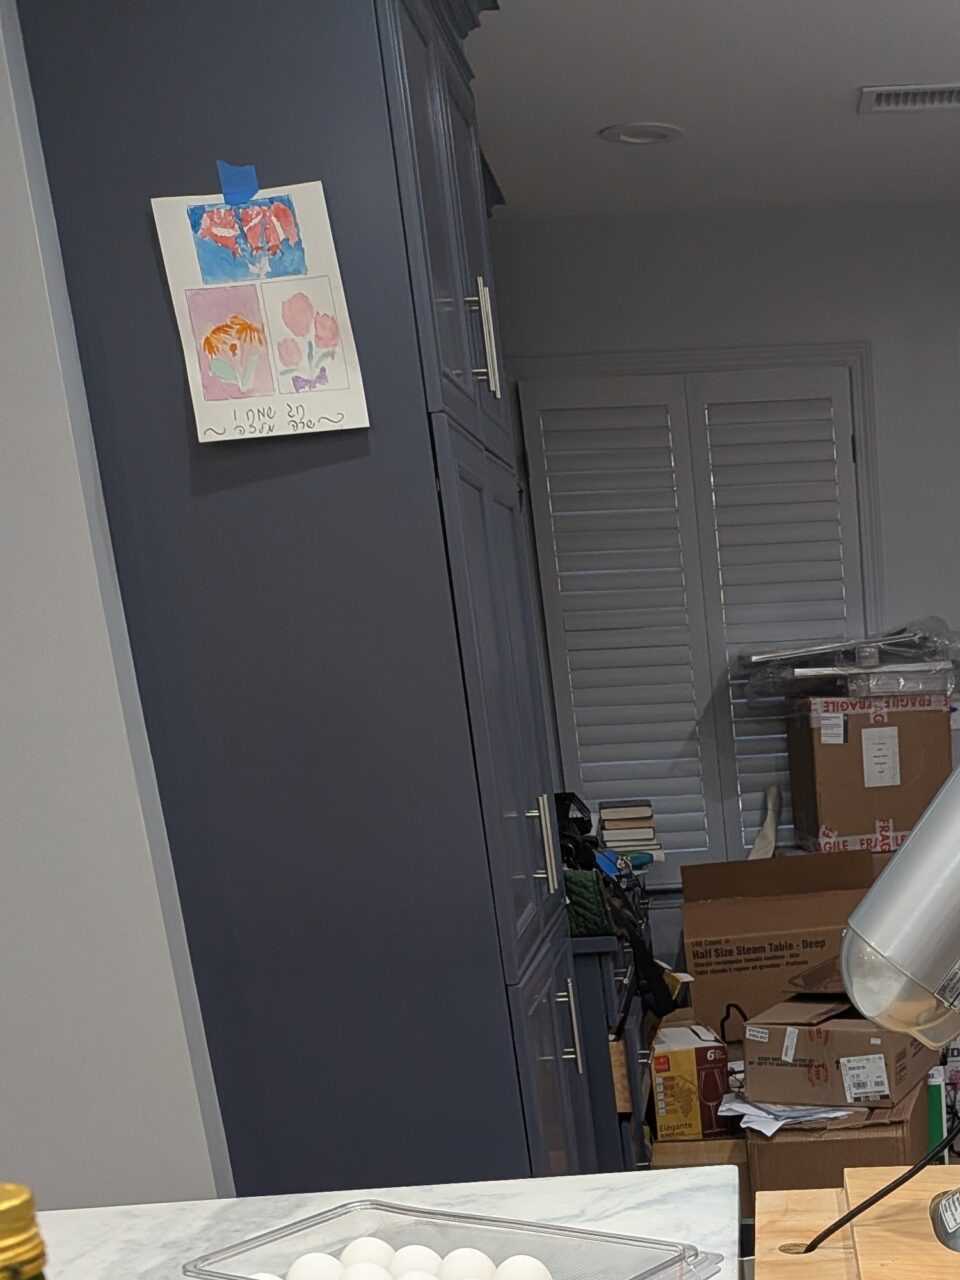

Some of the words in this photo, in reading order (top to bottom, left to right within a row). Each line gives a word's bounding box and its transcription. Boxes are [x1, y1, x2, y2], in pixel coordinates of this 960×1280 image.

[823, 700, 873, 713] FRAGILE
[879, 819, 891, 851] FRAG
[692, 949, 711, 960] Half
[714, 947, 734, 958] Size
[736, 945, 766, 956] Steam
[768, 941, 793, 953] Table
[802, 939, 826, 950] Deep
[706, 1049, 715, 1061] 6
[659, 1121, 692, 1132] Elegante
